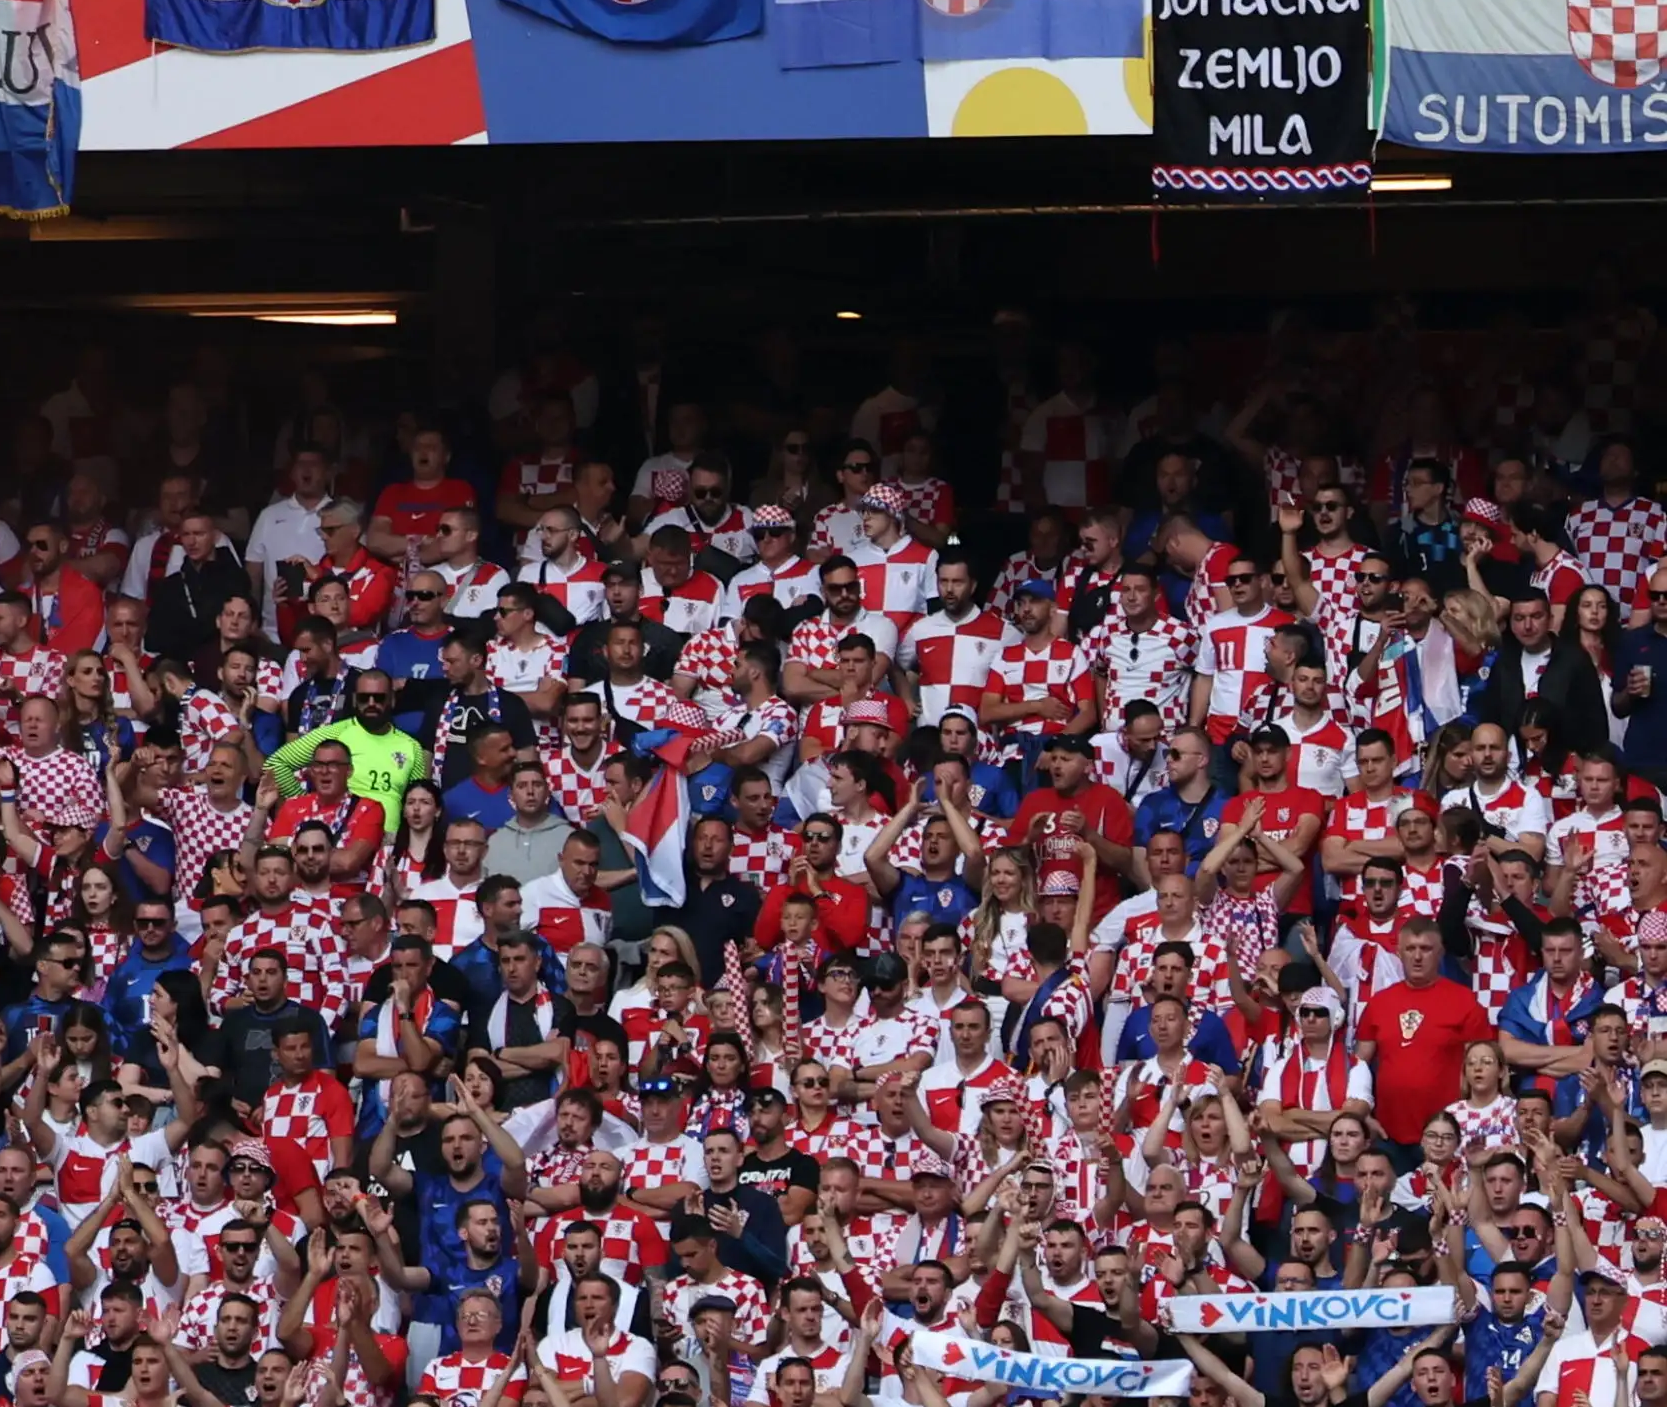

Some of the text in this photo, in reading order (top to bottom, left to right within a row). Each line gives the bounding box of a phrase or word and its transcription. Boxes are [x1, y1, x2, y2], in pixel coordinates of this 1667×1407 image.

[1177, 45, 1342, 94] ZEMLJO
[1208, 113, 1313, 156] MILA
[1218, 641, 1236, 670] 11
[411, 664, 429, 679] 17
[369, 770, 392, 792] 23
[1501, 1349, 1522, 1369] 14
